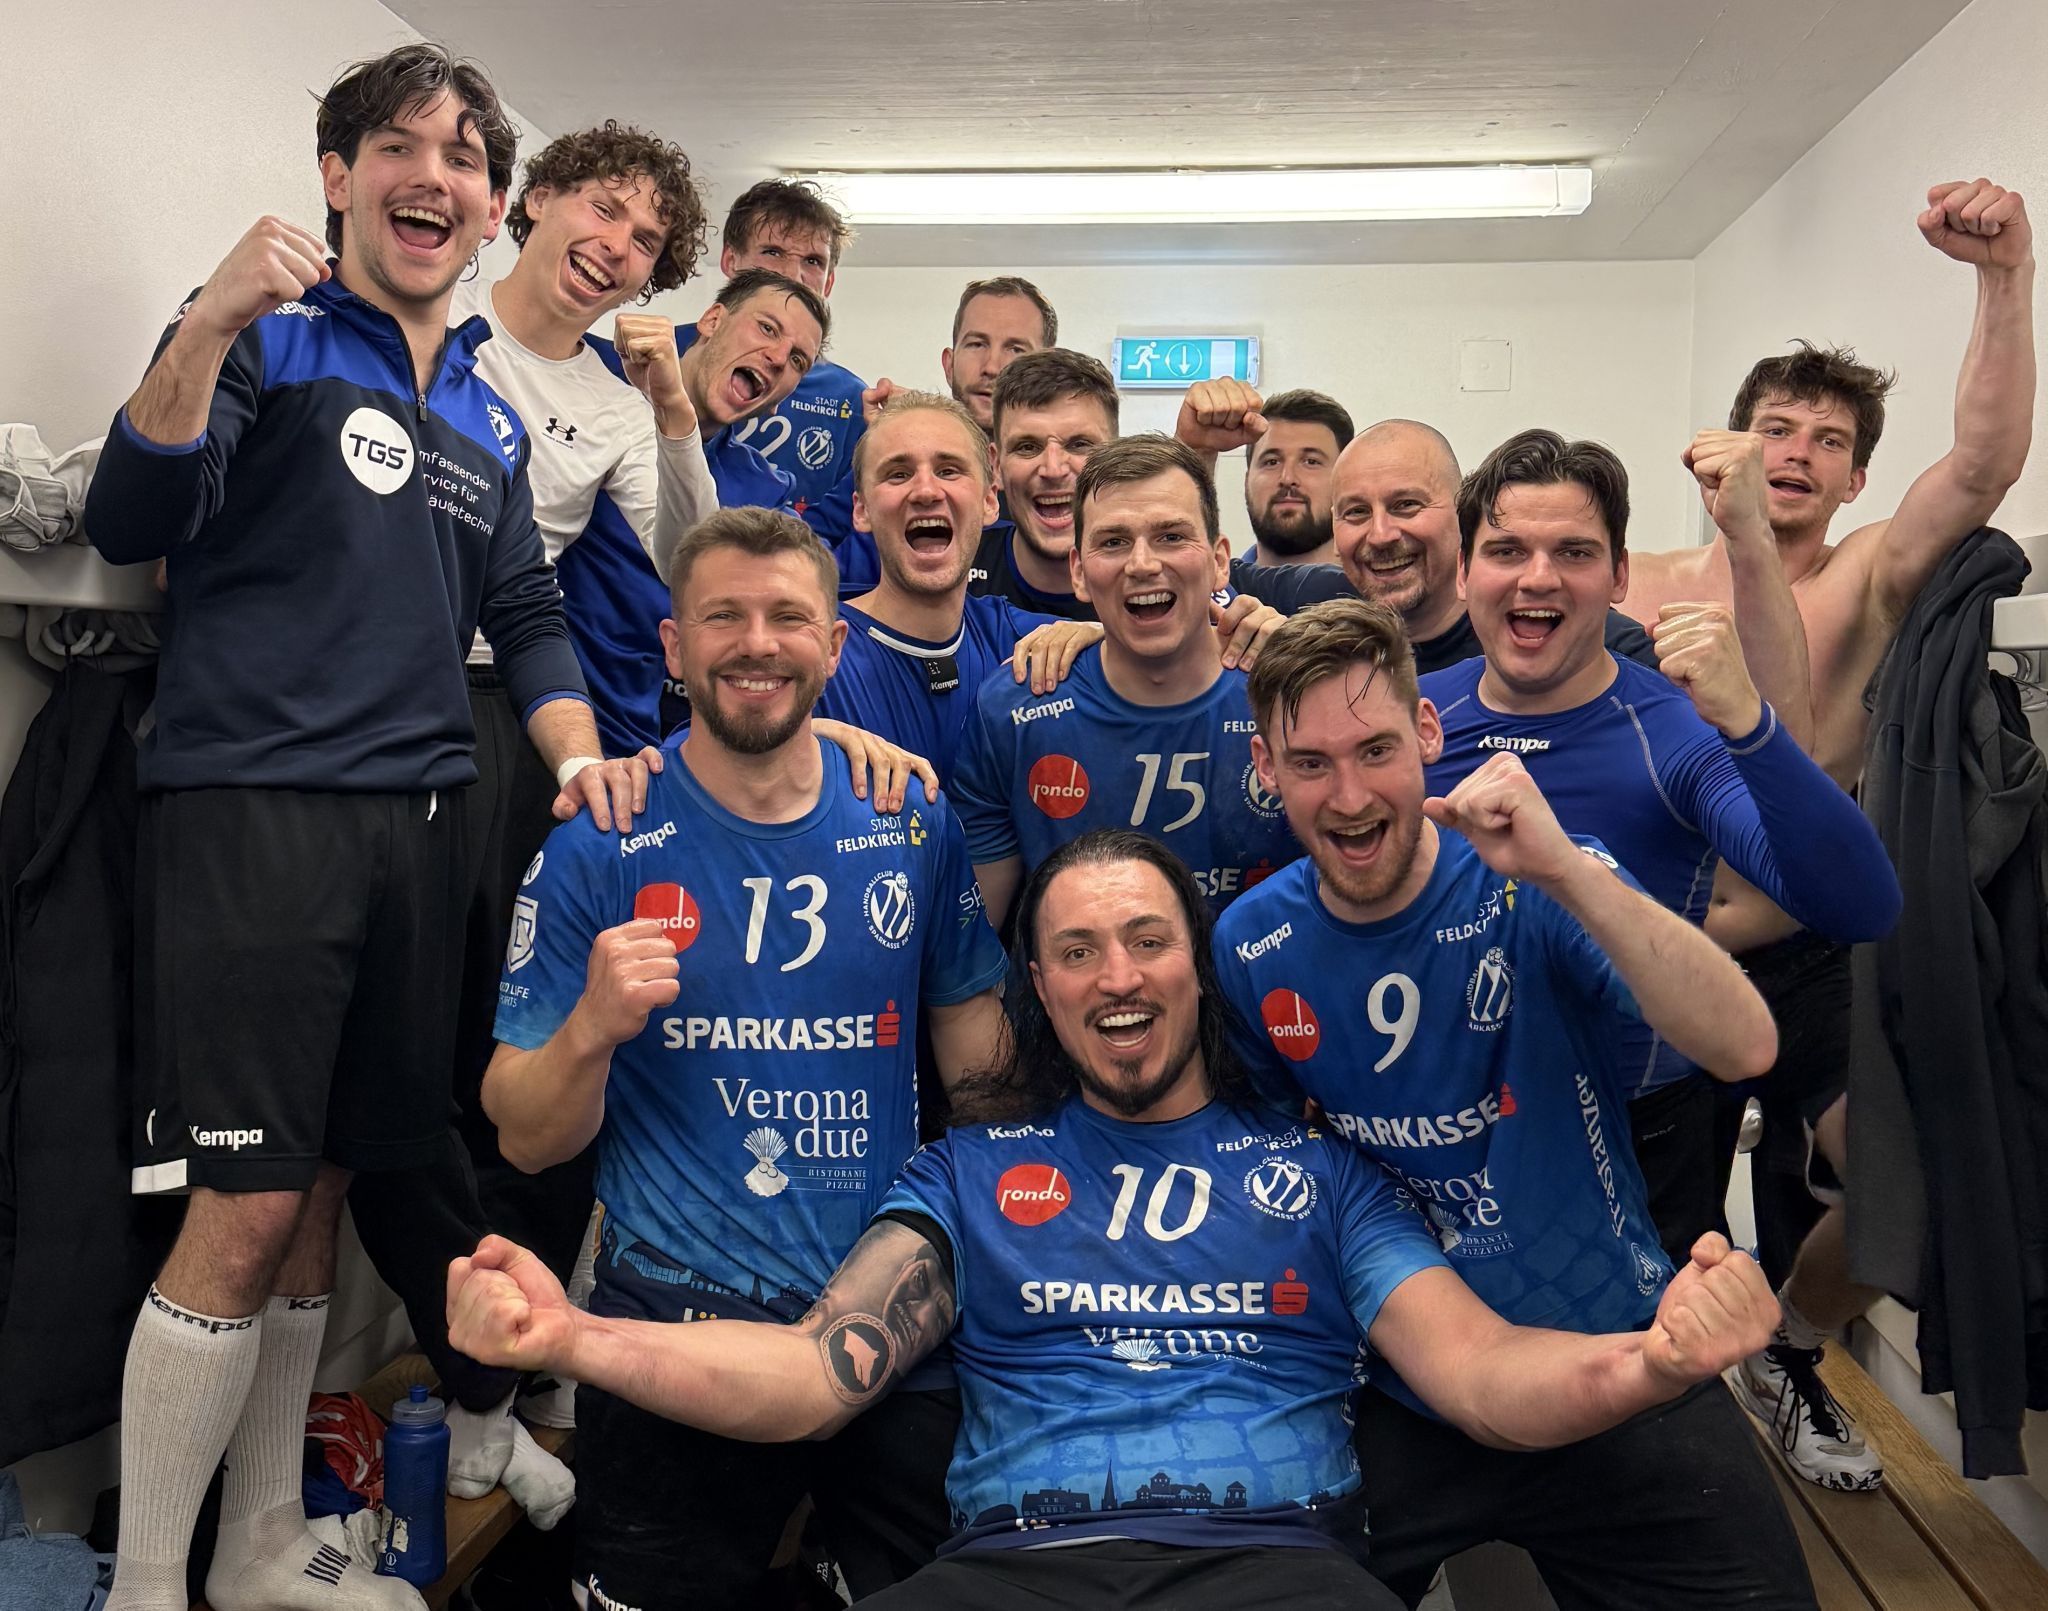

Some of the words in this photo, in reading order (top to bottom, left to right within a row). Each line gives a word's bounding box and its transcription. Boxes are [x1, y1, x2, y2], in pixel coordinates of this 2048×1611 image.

[791, 400, 837, 417] FELDKIRCH
[815, 397, 838, 407] STADT
[348, 432, 407, 470] TGS
[419, 450, 491, 491] mfassender
[422, 473, 458, 494] rvice
[461, 485, 479, 504] für
[428, 494, 494, 536] äudetechni
[931, 678, 959, 690] Kempa
[1011, 697, 1075, 725] Kempa
[1223, 720, 1257, 733] FELD
[1477, 735, 1551, 753] Kempa
[1033, 760, 1085, 803] rondo
[1129, 751, 1210, 833] 15
[619, 820, 679, 858] Kempa
[870, 816, 901, 831] STADT
[835, 831, 906, 854] FELDKIRCH
[661, 886, 697, 929] ndo
[742, 873, 828, 972] 13
[868, 925, 900, 950] SPARKASSE
[1236, 921, 1293, 963] Kempa
[510, 984, 530, 999] LIFE
[662, 1014, 875, 1050] SPARKASSE
[1367, 972, 1421, 1073] 9
[712, 1077, 870, 1122] Verona
[189, 1124, 264, 1151] Kempa
[795, 1115, 870, 1159] due
[1325, 1092, 1500, 1148] SPARKASSE
[808, 1168, 867, 1179] RISTORANTE
[826, 1180, 866, 1190] PIZZERIA
[1000, 1167, 1066, 1213] rondo
[1106, 1162, 1212, 1242] 10
[147, 1286, 254, 1334] Kempa
[1020, 1281, 1265, 1315] SPARKASSE
